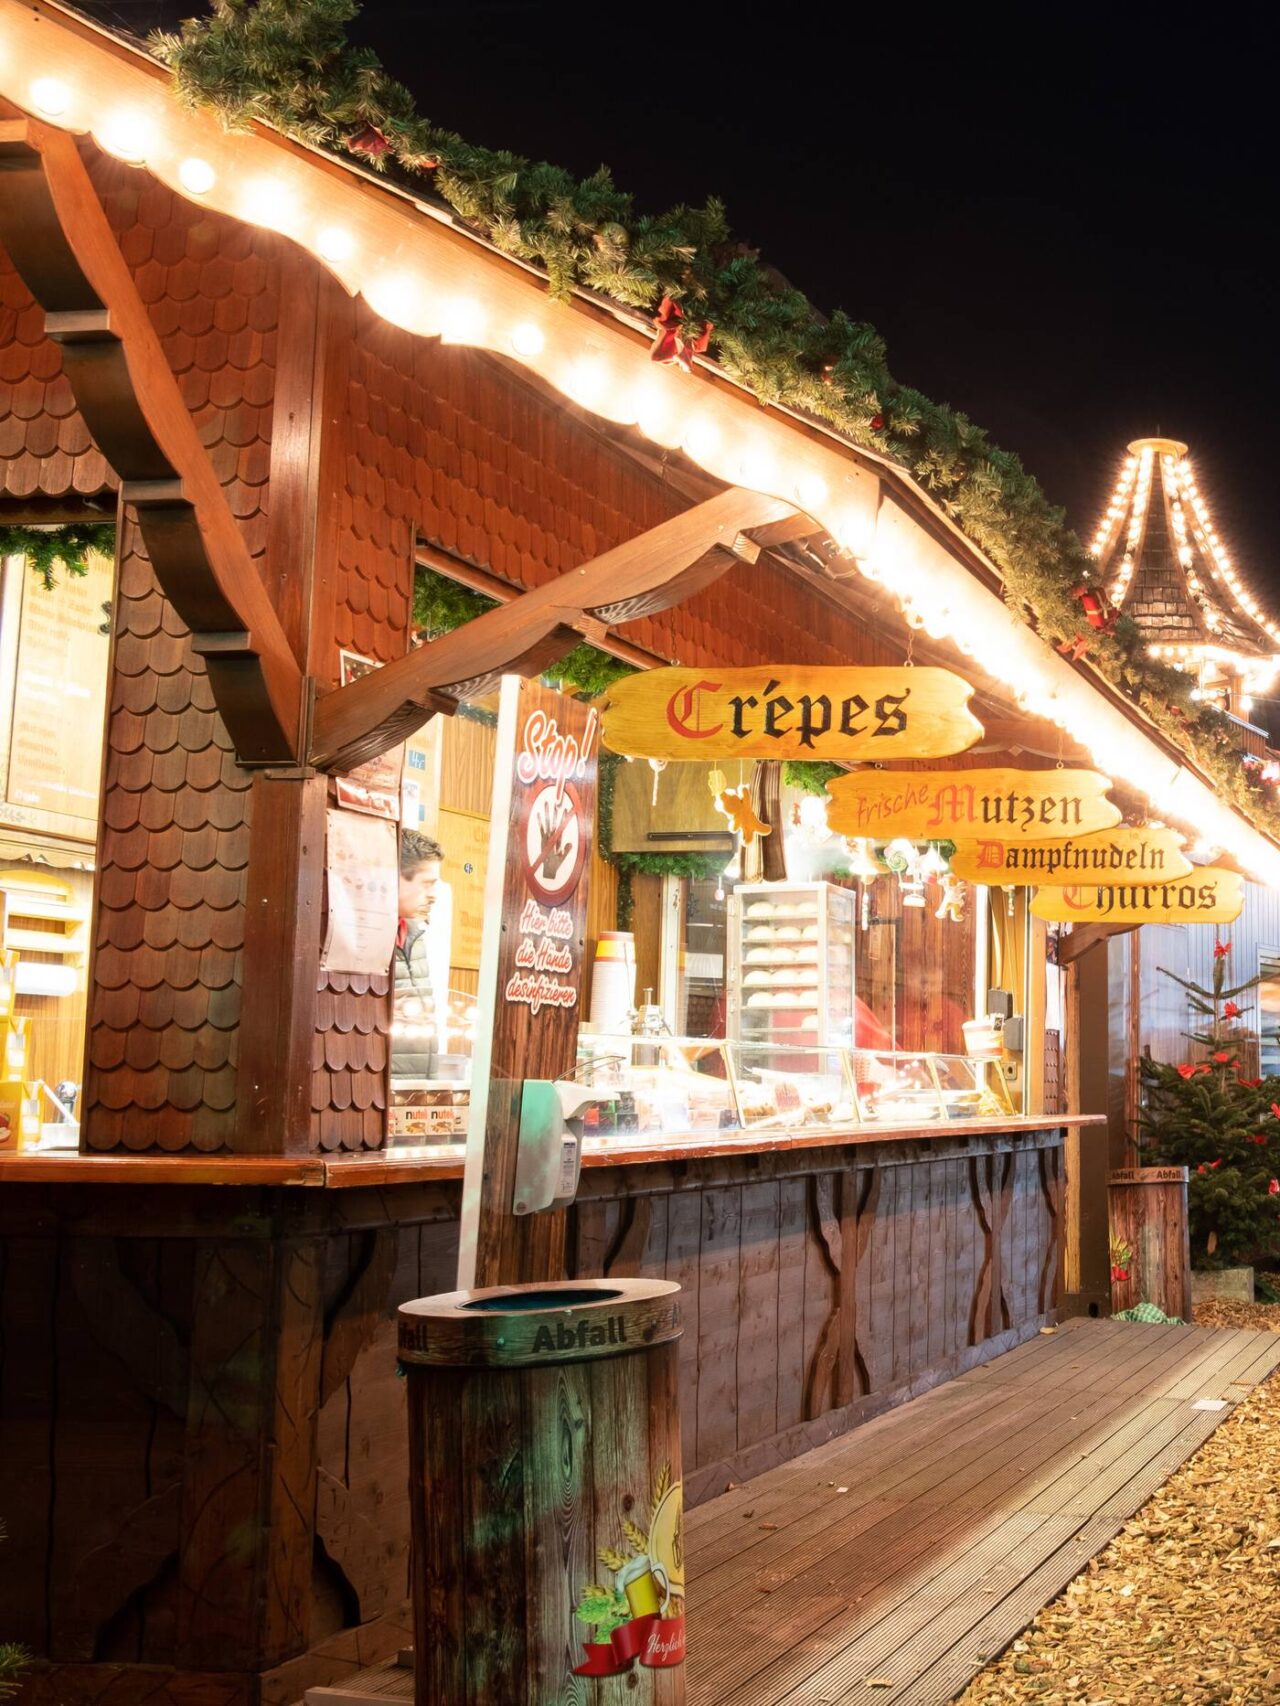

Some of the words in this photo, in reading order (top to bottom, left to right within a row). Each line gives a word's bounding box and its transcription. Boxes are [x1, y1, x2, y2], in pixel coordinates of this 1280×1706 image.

[666, 680, 911, 749] Crépes
[517, 707, 597, 804] Stop!
[928, 783, 1083, 832] Mutzen
[976, 839, 1166, 874] Dampfnudeln
[1062, 881, 1218, 916] Churros
[519, 899, 548, 935] Hier
[546, 907, 573, 939] bitte
[515, 938, 537, 968] die
[535, 937, 573, 973] Hände
[506, 972, 577, 1015] desinfizieren
[531, 1316, 627, 1353] Abfall
